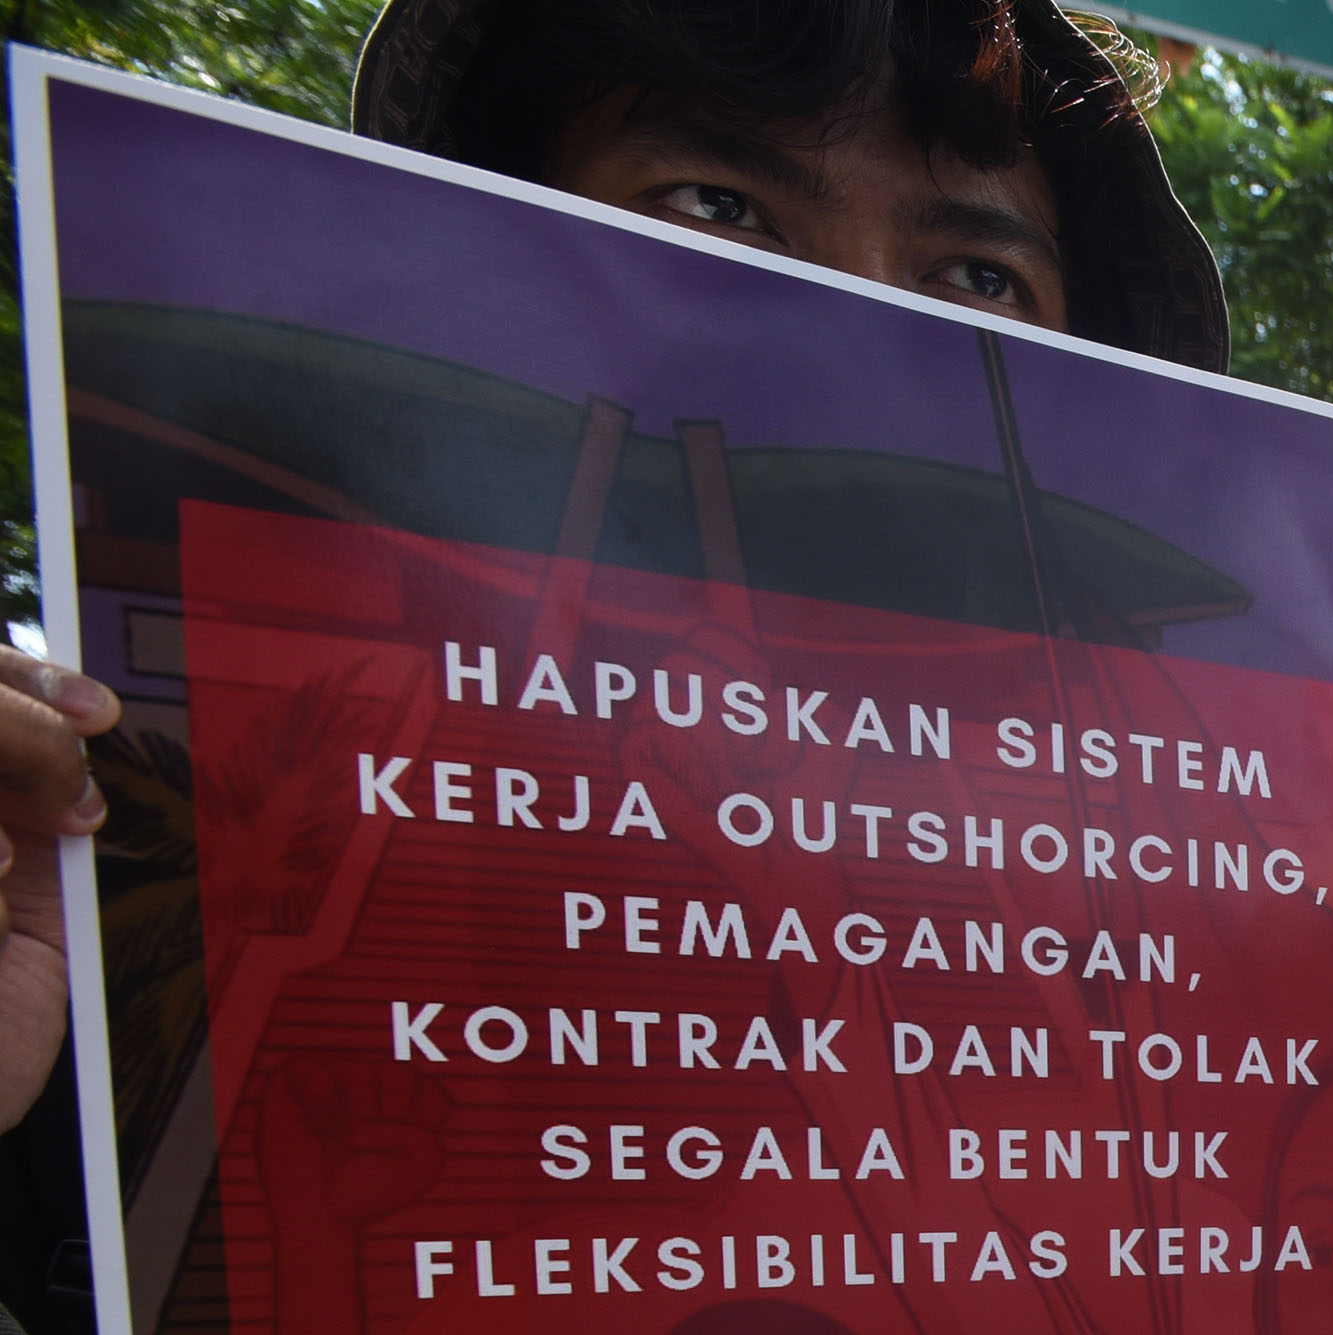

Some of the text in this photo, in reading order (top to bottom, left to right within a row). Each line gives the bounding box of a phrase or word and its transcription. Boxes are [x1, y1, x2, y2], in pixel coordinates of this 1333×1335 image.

[446, 642, 1272, 798] HAPUSKAN SISTEM
[359, 754, 1328, 905] KERJA OUTSHORCING,
[565, 892, 1200, 991] PEMAGANGAN,
[393, 1002, 1318, 1085] KONTRAK DAN TOLAK
[541, 1125, 1228, 1180] SEGALA BENTUK
[416, 1226, 1312, 1298] FLEKSIBILITAS KERJA
